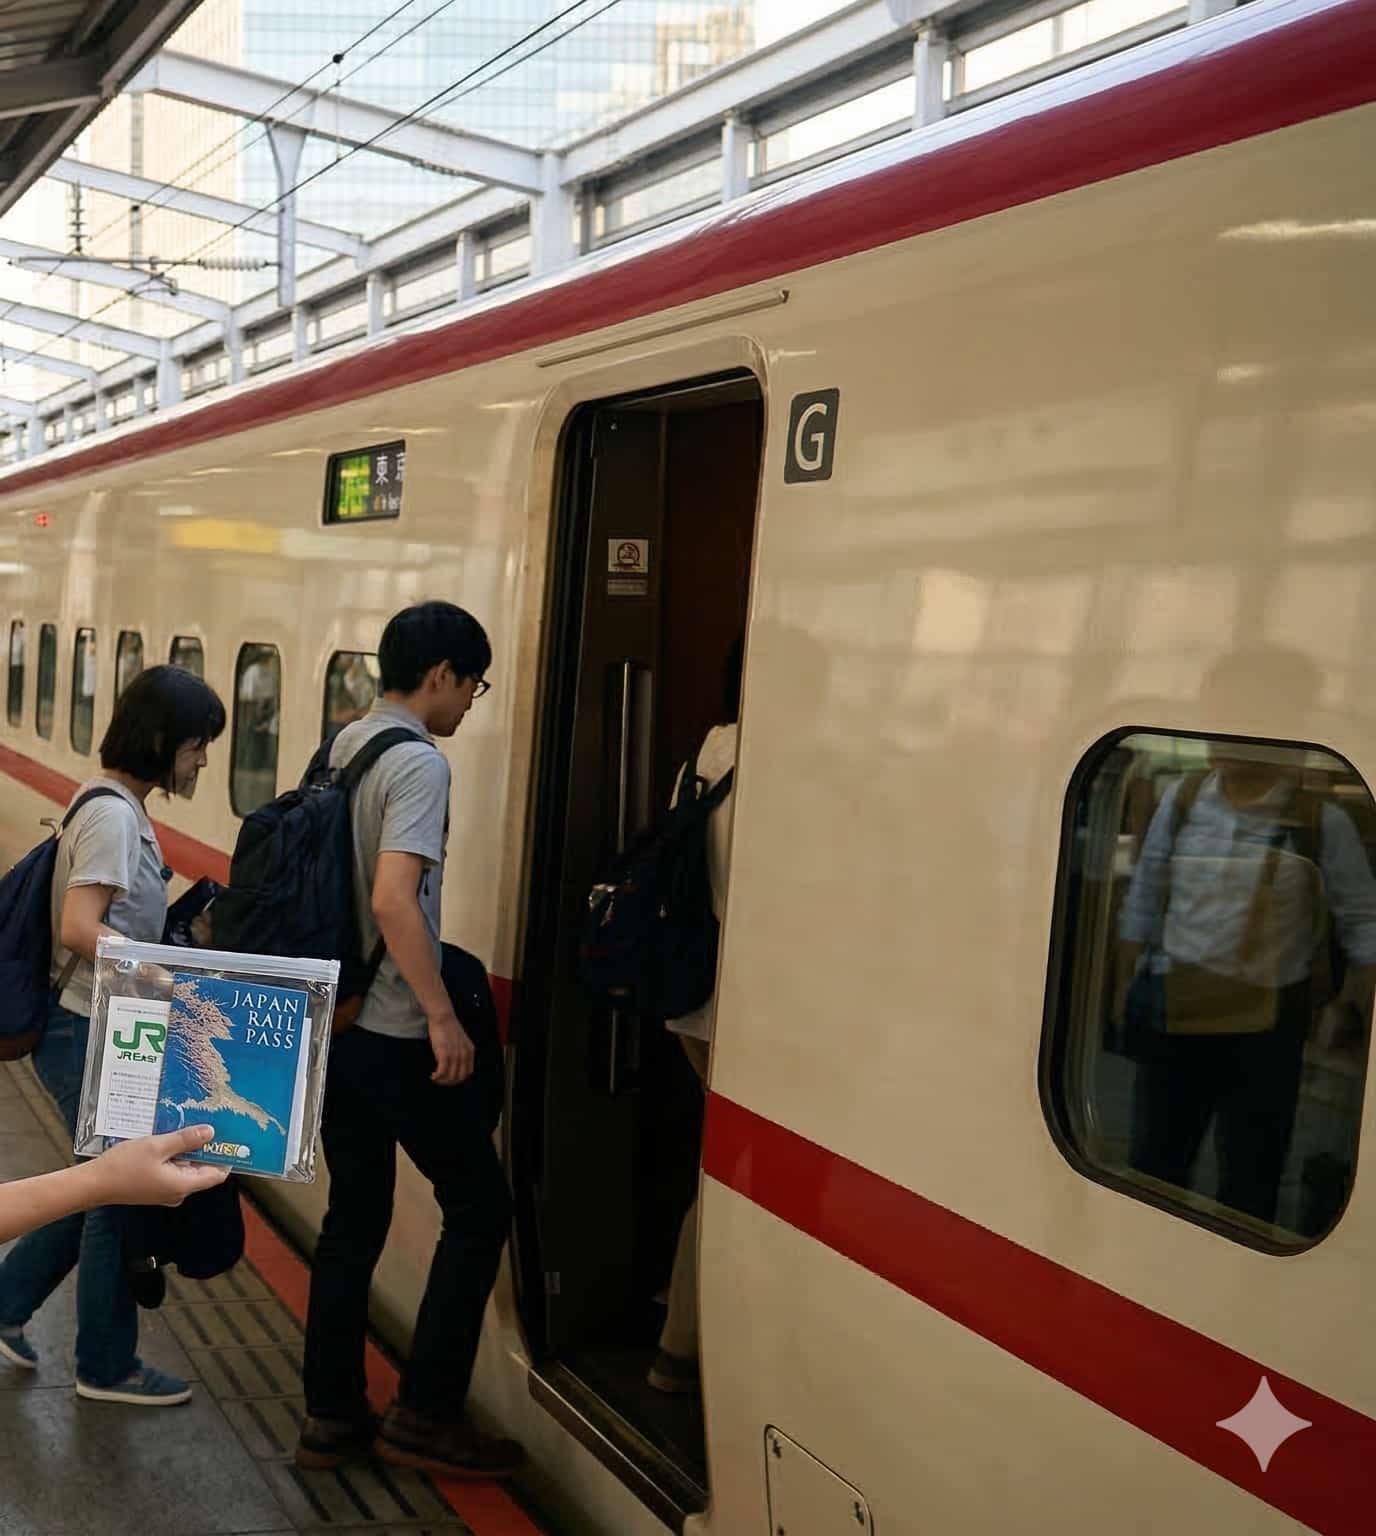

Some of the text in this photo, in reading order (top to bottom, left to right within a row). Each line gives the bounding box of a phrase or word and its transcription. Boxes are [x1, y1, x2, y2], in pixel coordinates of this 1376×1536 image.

[794, 402, 828, 471] G
[231, 990, 299, 1014] JAPAN
[248, 1010, 295, 1032] RAIL
[113, 1021, 166, 1053] JR
[246, 1028, 294, 1049] PASS
